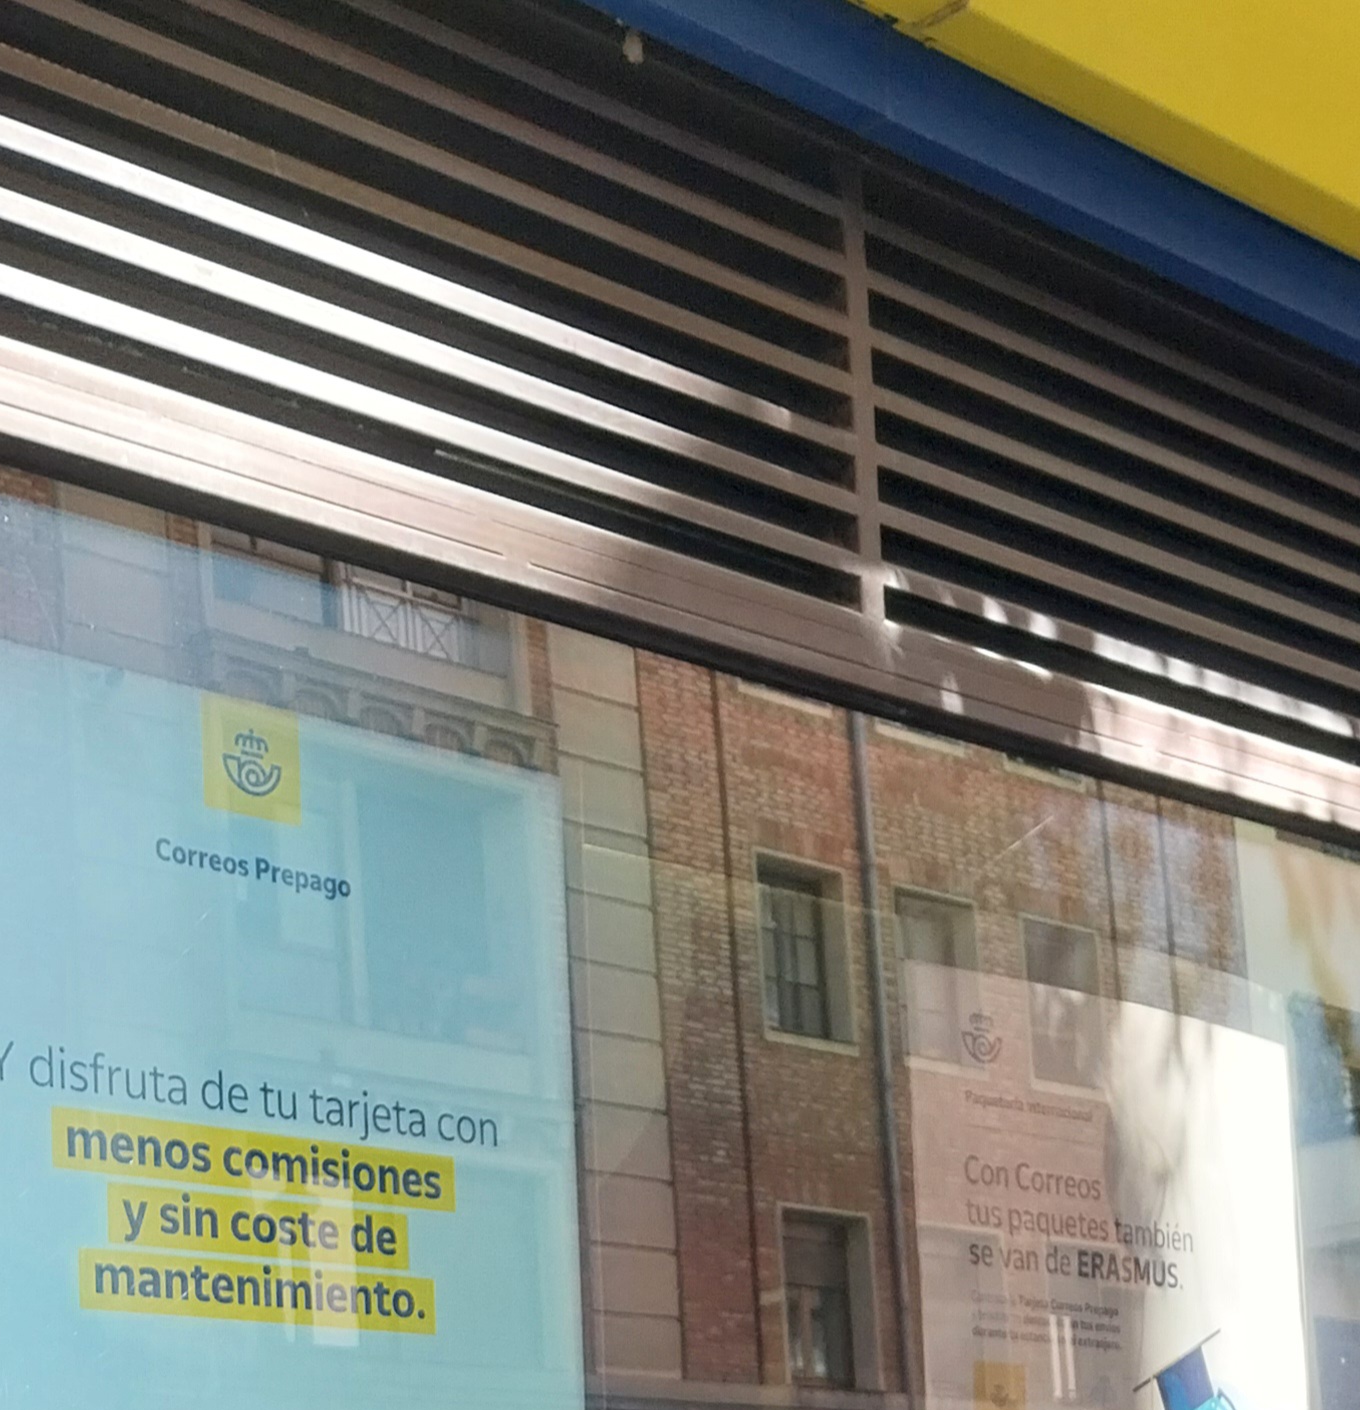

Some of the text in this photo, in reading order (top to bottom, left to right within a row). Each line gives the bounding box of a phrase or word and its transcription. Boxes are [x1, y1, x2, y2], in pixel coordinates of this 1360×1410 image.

[155, 838, 352, 900] Correos Prepago
[29, 1046, 187, 1107] disfruta
[201, 1070, 249, 1115] de
[258, 1081, 298, 1121] tu
[310, 1084, 427, 1141] tarjeta
[438, 1109, 499, 1147] con
[66, 1120, 442, 1200] menos comisiones
[964, 1154, 1102, 1201] Con Correos
[122, 1194, 397, 1255] y sin coste de
[965, 1199, 1193, 1253] tus paquetes también
[94, 1257, 427, 1320] mantenimiento.
[968, 1243, 1184, 1290] se van de ERASMUS.
